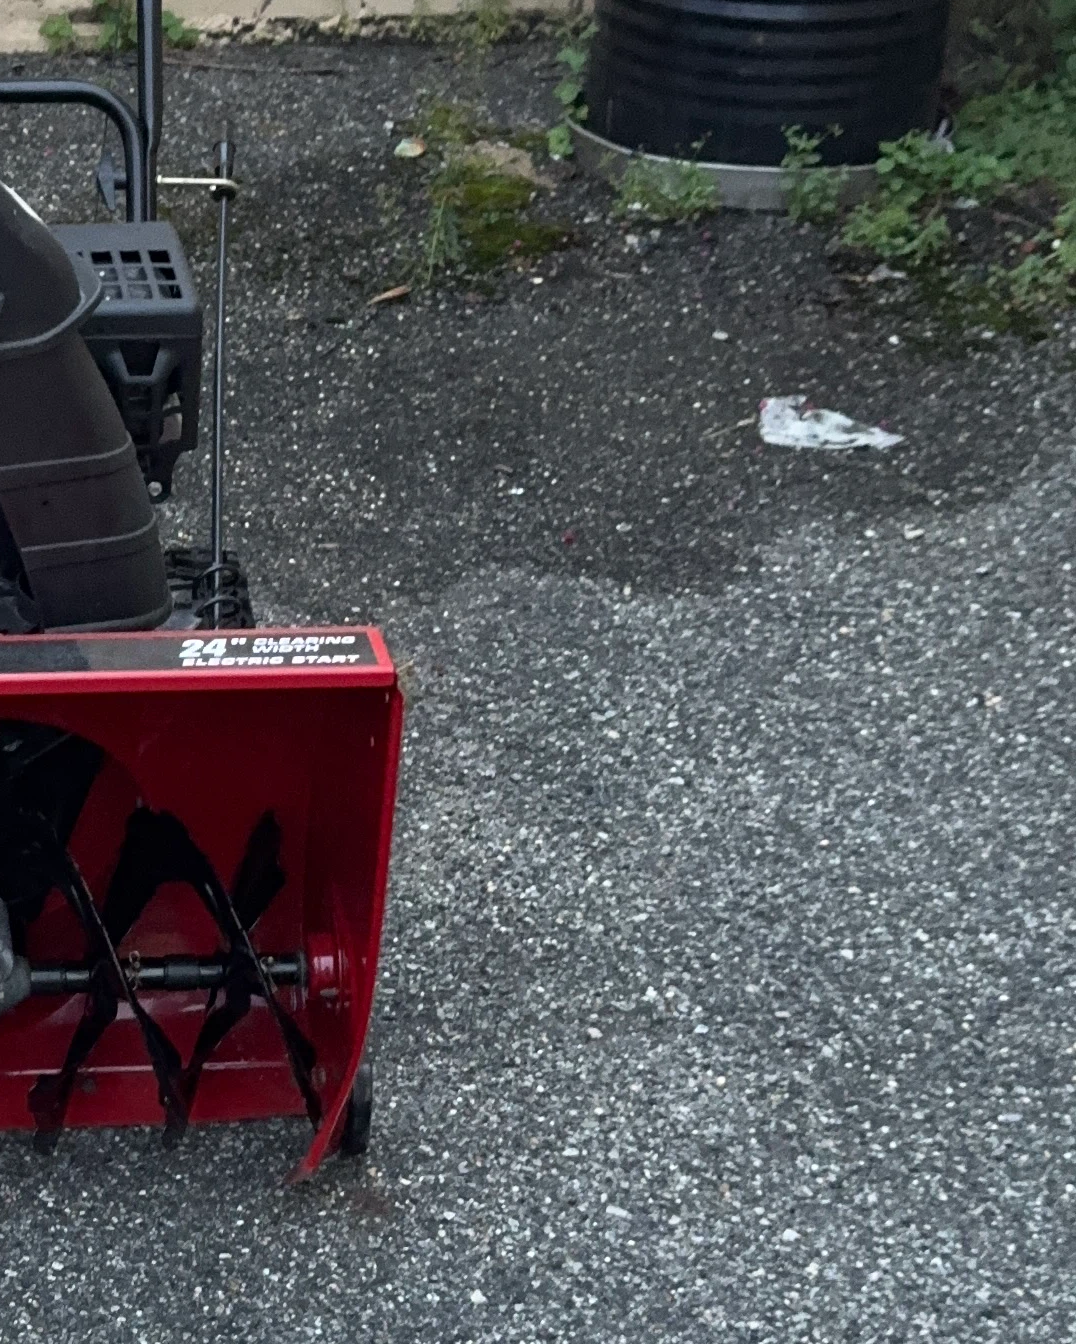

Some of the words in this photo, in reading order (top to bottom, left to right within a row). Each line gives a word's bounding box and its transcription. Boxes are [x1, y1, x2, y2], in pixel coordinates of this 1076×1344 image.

[254, 635, 356, 645] CLEARING
[252, 644, 319, 654] WIDTH
[182, 656, 283, 666] ELECTRIC
[291, 654, 360, 665] START
